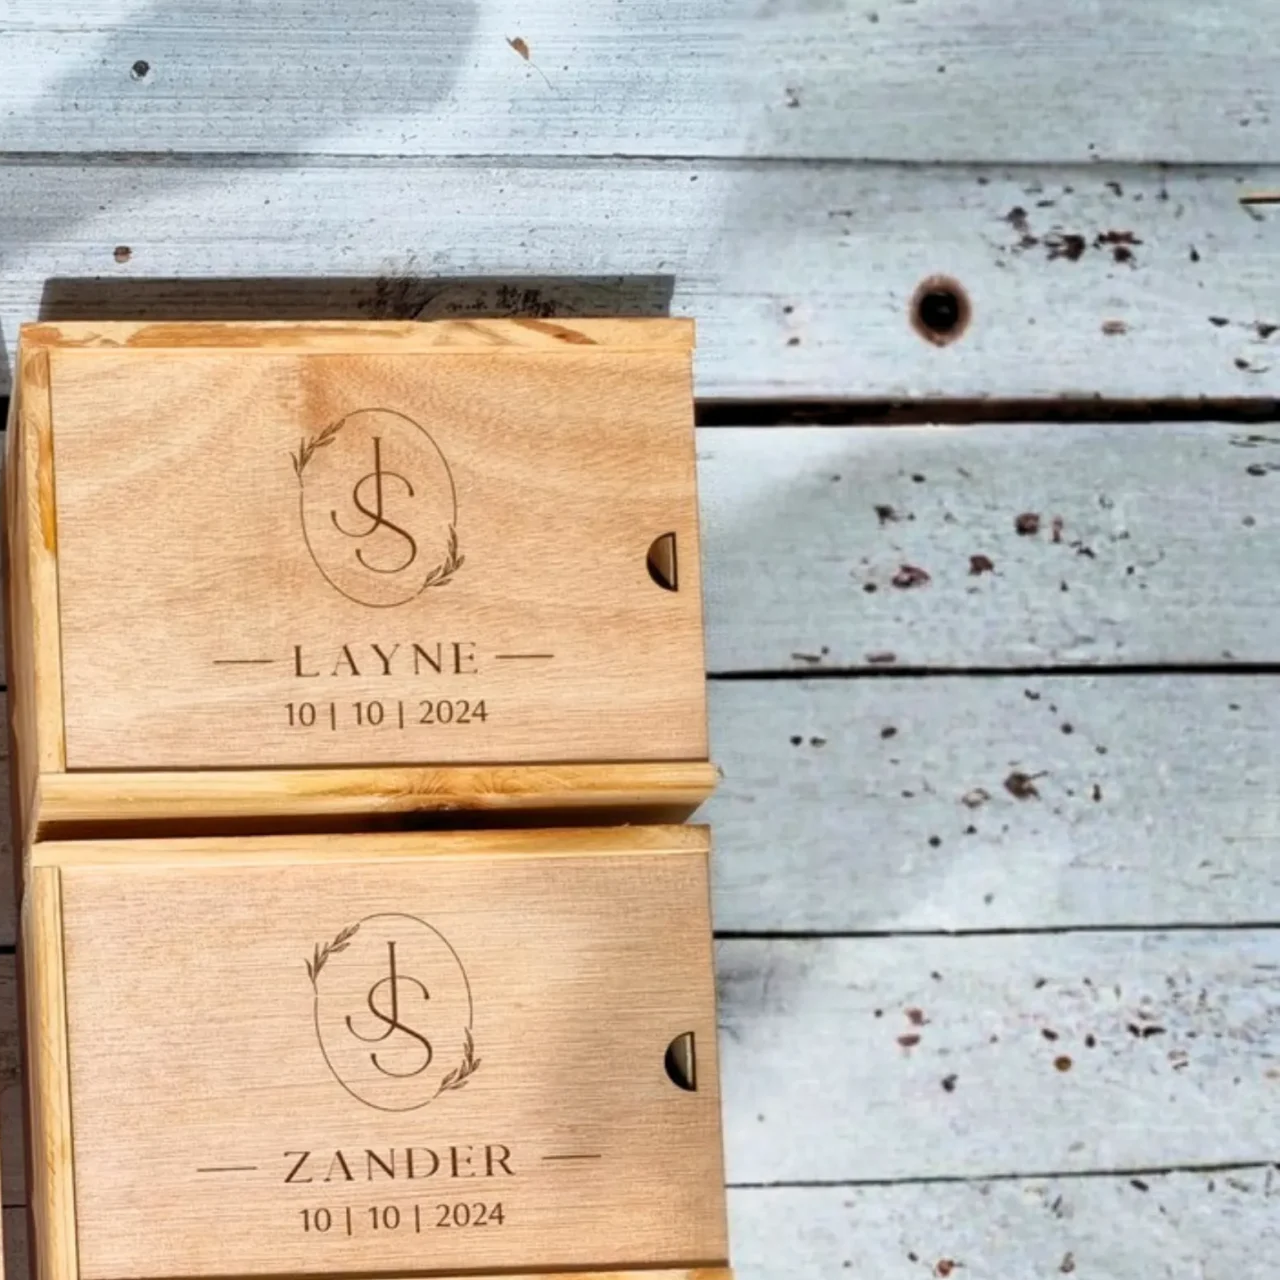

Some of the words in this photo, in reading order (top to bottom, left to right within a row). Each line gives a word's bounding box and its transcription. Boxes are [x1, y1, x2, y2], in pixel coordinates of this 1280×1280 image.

[293, 640, 479, 678] LAYNE
[284, 702, 317, 727] 10
[351, 700, 385, 727] 10
[418, 699, 489, 725] 2024
[282, 1142, 517, 1185] ZANDER
[299, 1207, 333, 1233] 10
[367, 1205, 401, 1230] 10
[435, 1201, 506, 1228] 2024
